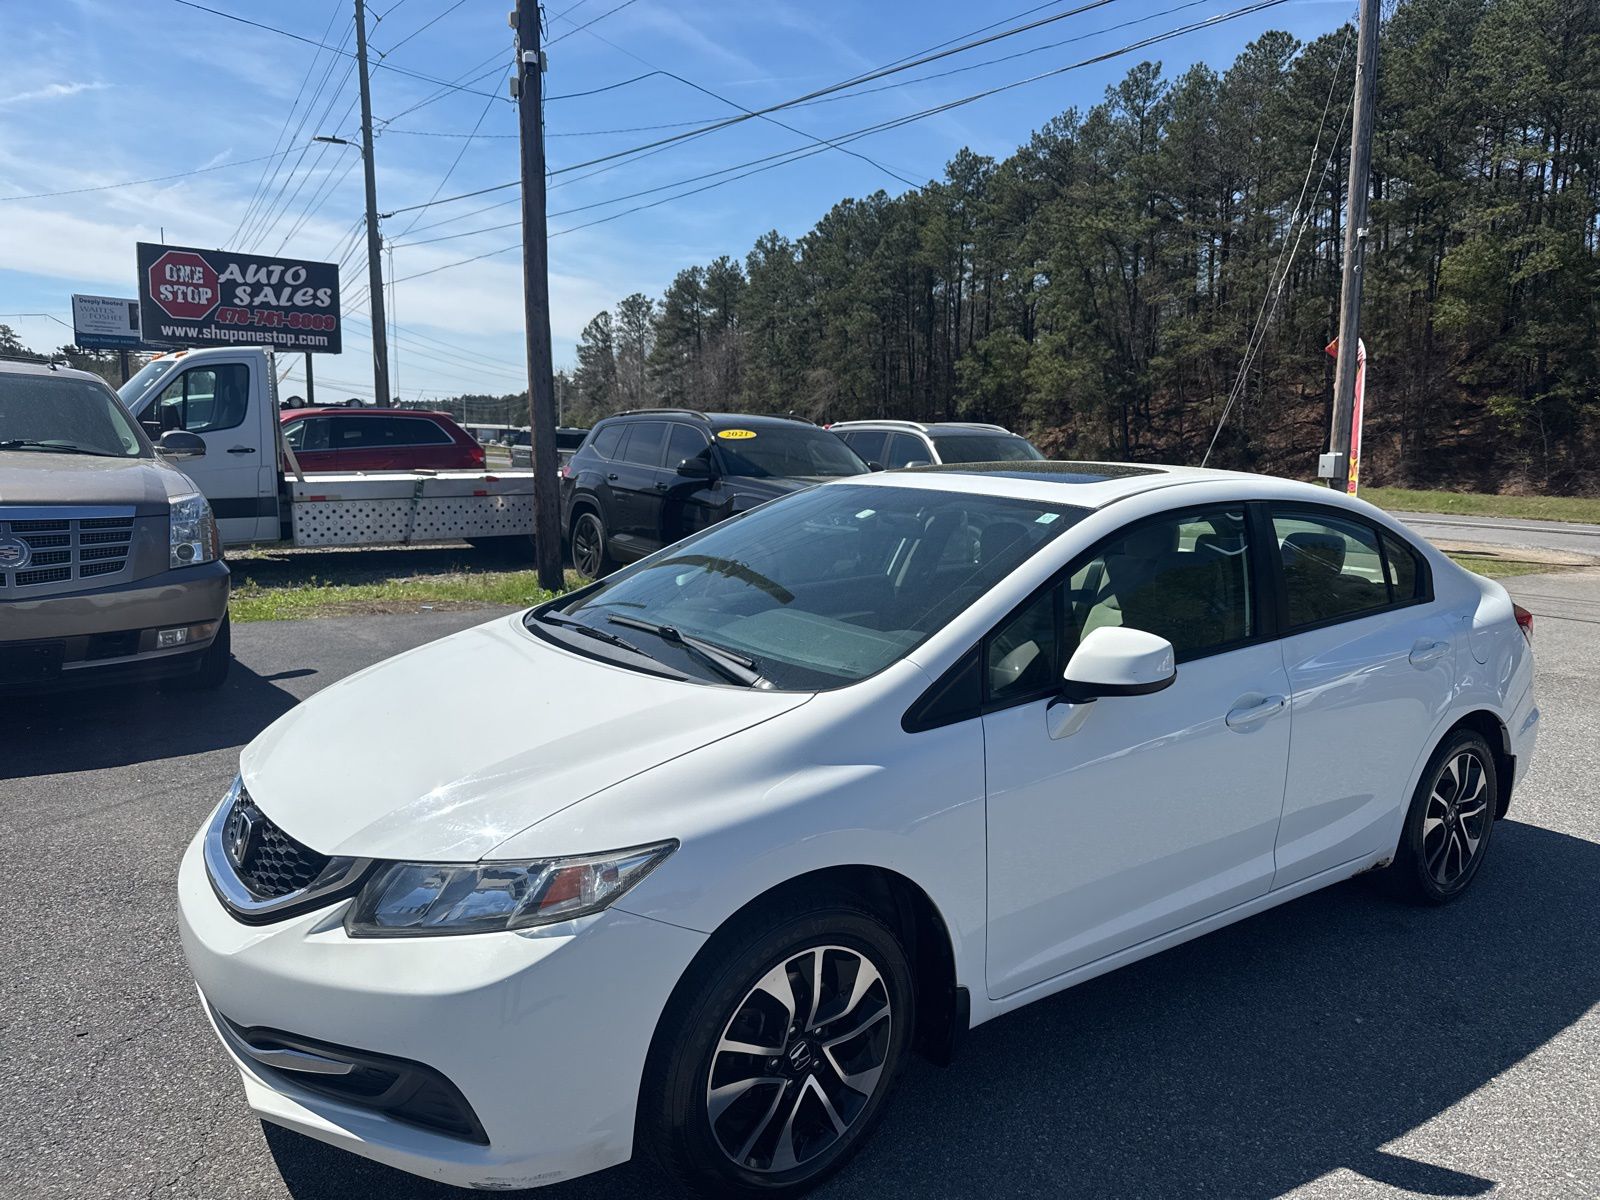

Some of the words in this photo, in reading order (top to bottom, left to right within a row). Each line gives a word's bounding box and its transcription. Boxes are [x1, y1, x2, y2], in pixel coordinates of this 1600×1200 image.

[165, 264, 203, 283] ONE
[218, 264, 307, 285] AUTO
[79, 297, 100, 306] Deeply
[159, 284, 212, 304] STOP
[161, 325, 328, 346] www.shoponestop.com
